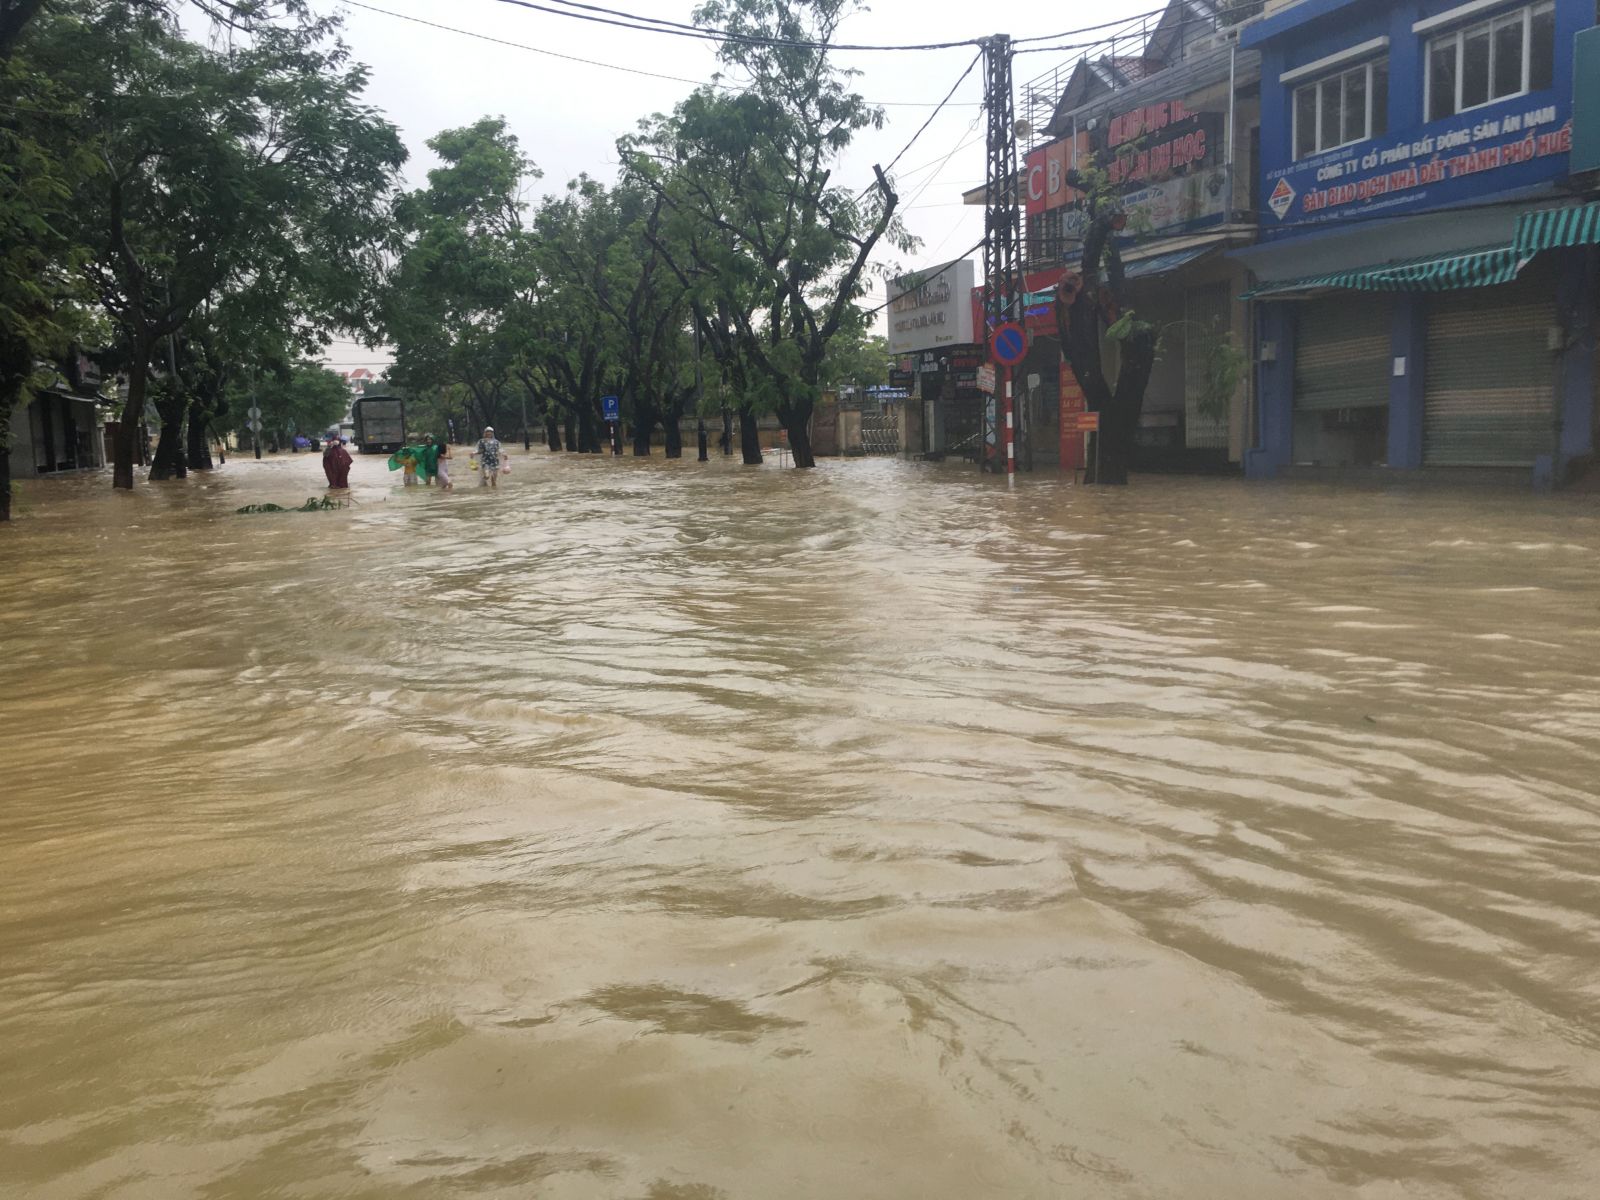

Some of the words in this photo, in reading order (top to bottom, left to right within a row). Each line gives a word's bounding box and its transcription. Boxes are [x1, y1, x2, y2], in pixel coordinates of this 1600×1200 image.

[1173, 128, 1205, 173] HỌC
[1317, 162, 1343, 182] CÔNG
[1345, 159, 1359, 174] TY
[1412, 134, 1435, 157] BẤT
[1437, 129, 1471, 152] ĐỘNG
[1523, 105, 1556, 128] NAM
[1327, 182, 1357, 207] GIAO
[1357, 174, 1389, 203] DỊCH
[1390, 161, 1418, 190] NHÀ
[1420, 152, 1447, 185] ĐẤT
[1447, 146, 1499, 178] THÀNH
[1500, 127, 1535, 165] PHỐ
[1535, 118, 1573, 157] HUẾ
[608, 399, 615, 409] P
